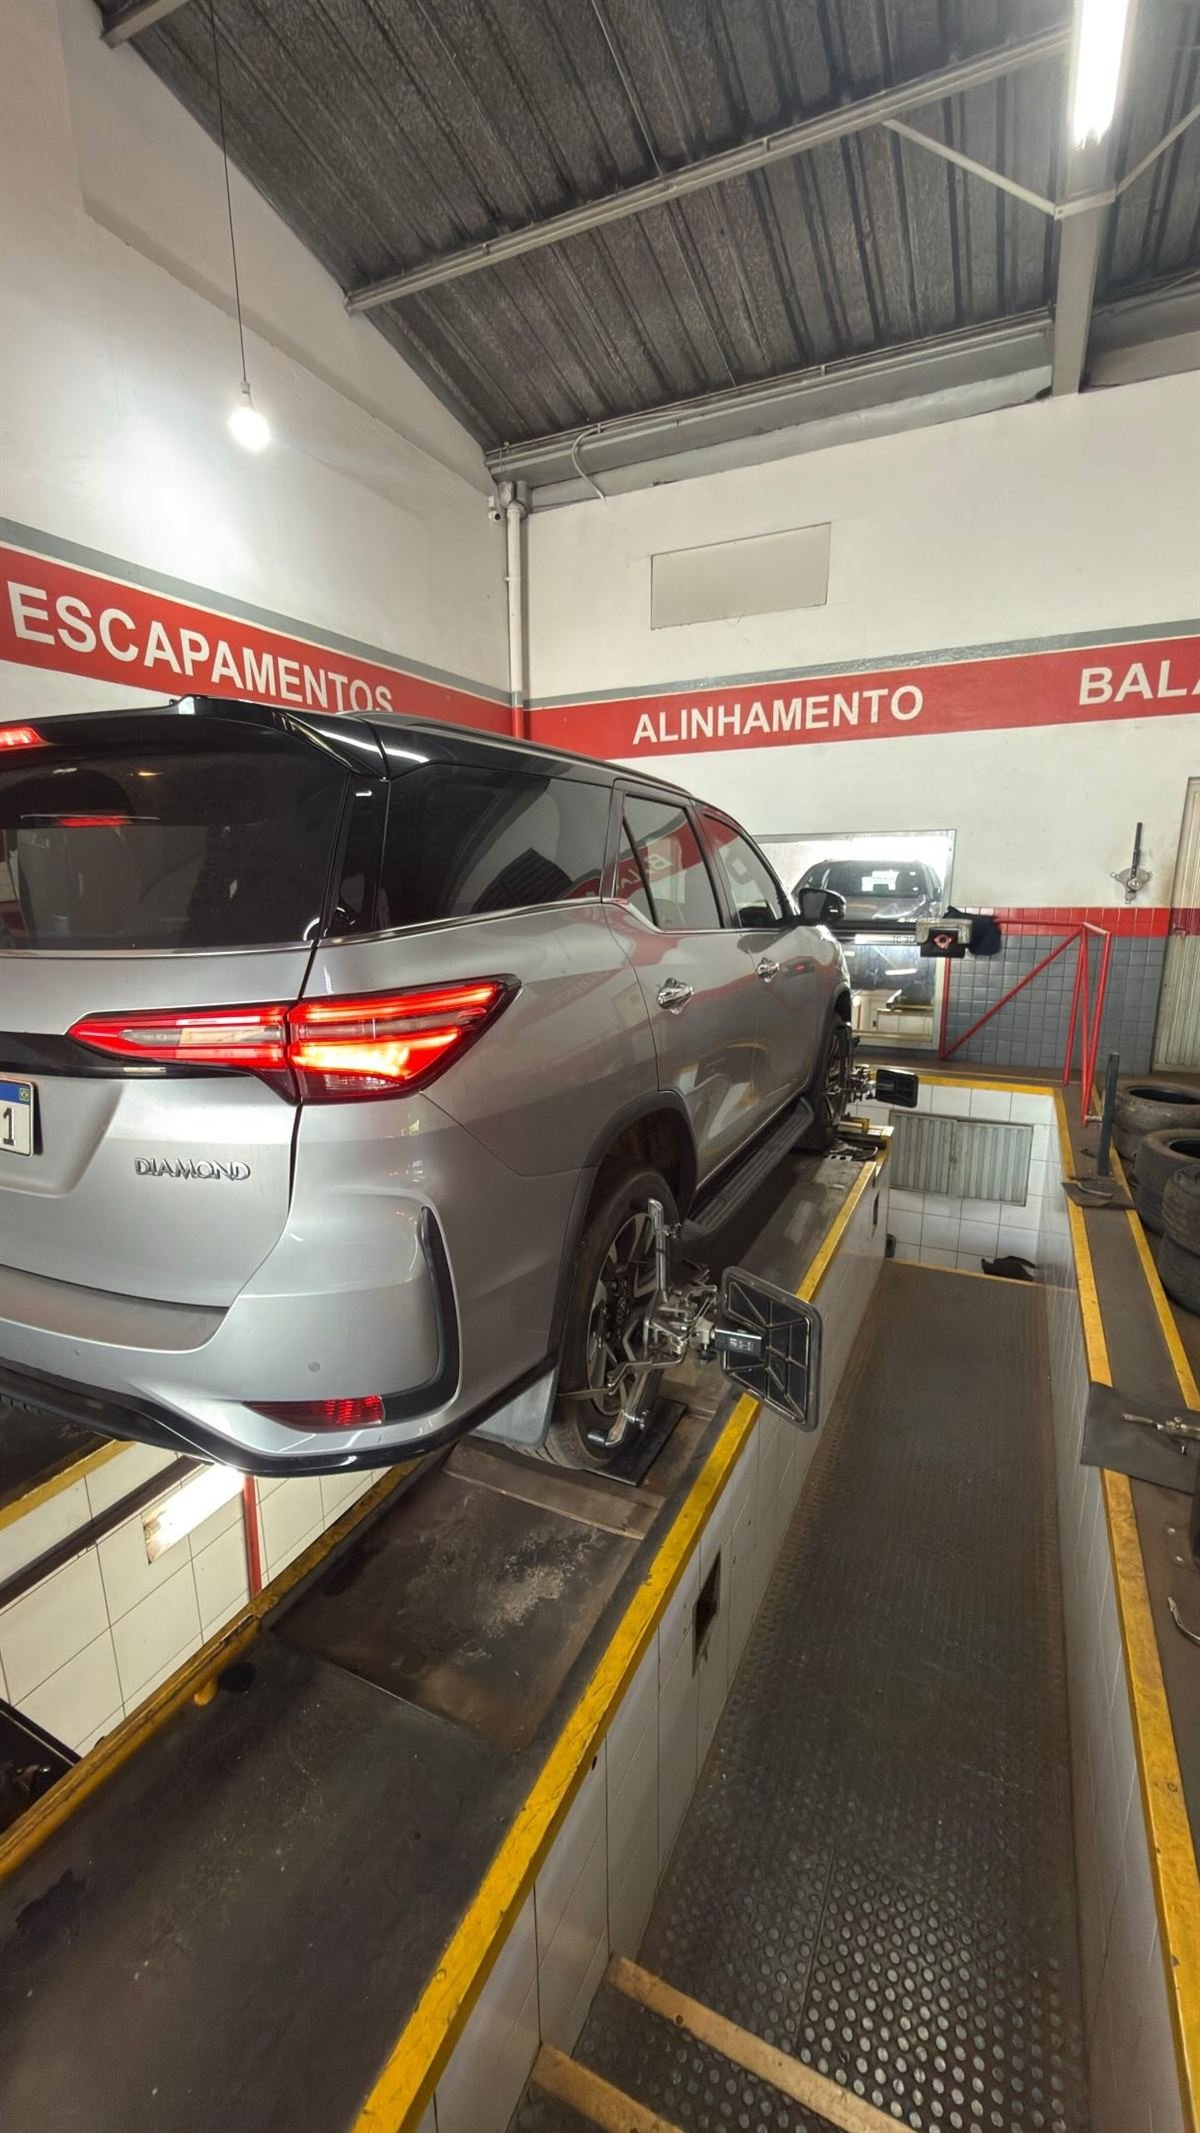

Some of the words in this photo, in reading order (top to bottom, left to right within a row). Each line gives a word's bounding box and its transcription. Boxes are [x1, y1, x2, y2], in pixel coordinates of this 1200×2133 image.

[7, 581, 393, 713] ESCAPAMENTOS
[1079, 660, 1200, 706] BAL
[632, 685, 924, 745] ALINHAMENTO
[135, 1157, 251, 1181] DIAMOND
